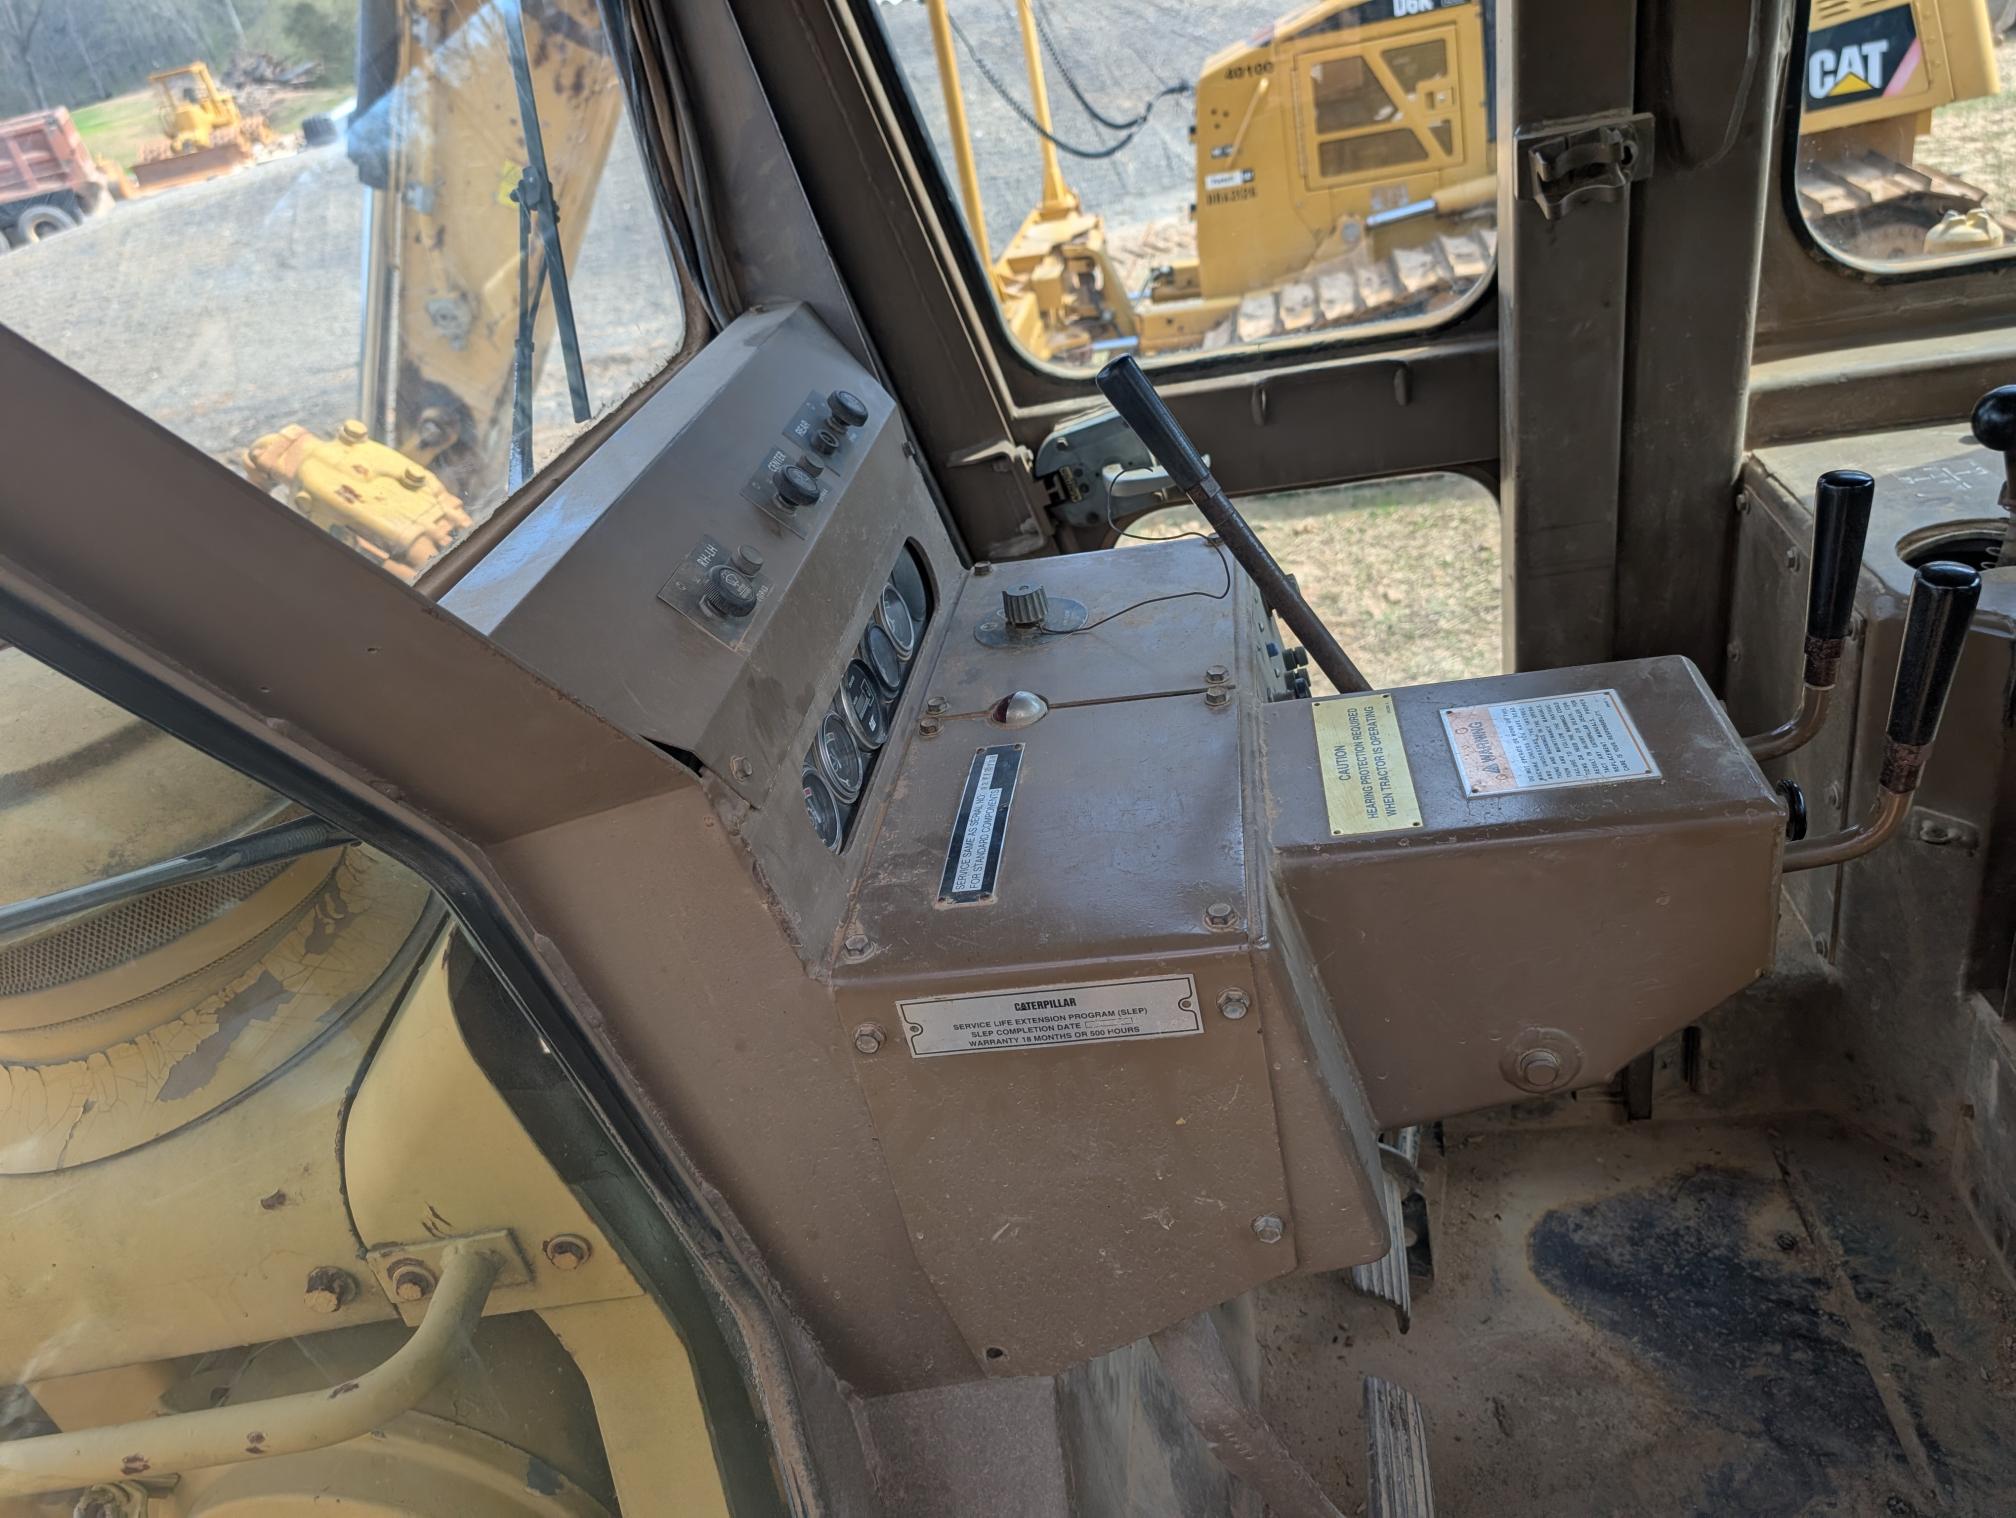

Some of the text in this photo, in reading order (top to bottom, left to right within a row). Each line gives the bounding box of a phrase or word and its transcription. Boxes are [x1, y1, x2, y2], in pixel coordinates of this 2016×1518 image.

[1809, 39, 1888, 99] CAT
[767, 450, 786, 473] CENTER
[696, 544, 718, 567] RH-LH
[1468, 721, 1495, 763] WARNING
[1334, 744, 1351, 780] CAUTION
[1347, 707, 1378, 818] HEARING PROTECTION REQUIRED
[1363, 706, 1396, 816] WHEN TRACTOR IS OPERATING
[969, 805, 982, 826] SERIAL
[981, 789, 999, 832] COMPONENTS
[967, 826, 977, 836] AS
[962, 837, 975, 857] SAME
[972, 834, 989, 871] STANDARD
[955, 859, 970, 889] SERVICE
[969, 873, 981, 888] FOR
[1014, 997, 1076, 1011] CATERPILLAR
[952, 1007, 1147, 1030] SERVICE LIFE EXTENSION PROGRAM (SLEP)
[996, 1024, 1054, 1035] COMPLETION
[1056, 1022, 1081, 1030] DATE
[968, 1037, 1018, 1046] WARRANTY
[1033, 1032, 1072, 1041] MONTHS
[1074, 1030, 1087, 1038] OR
[1107, 1026, 1139, 1034] HOURS
